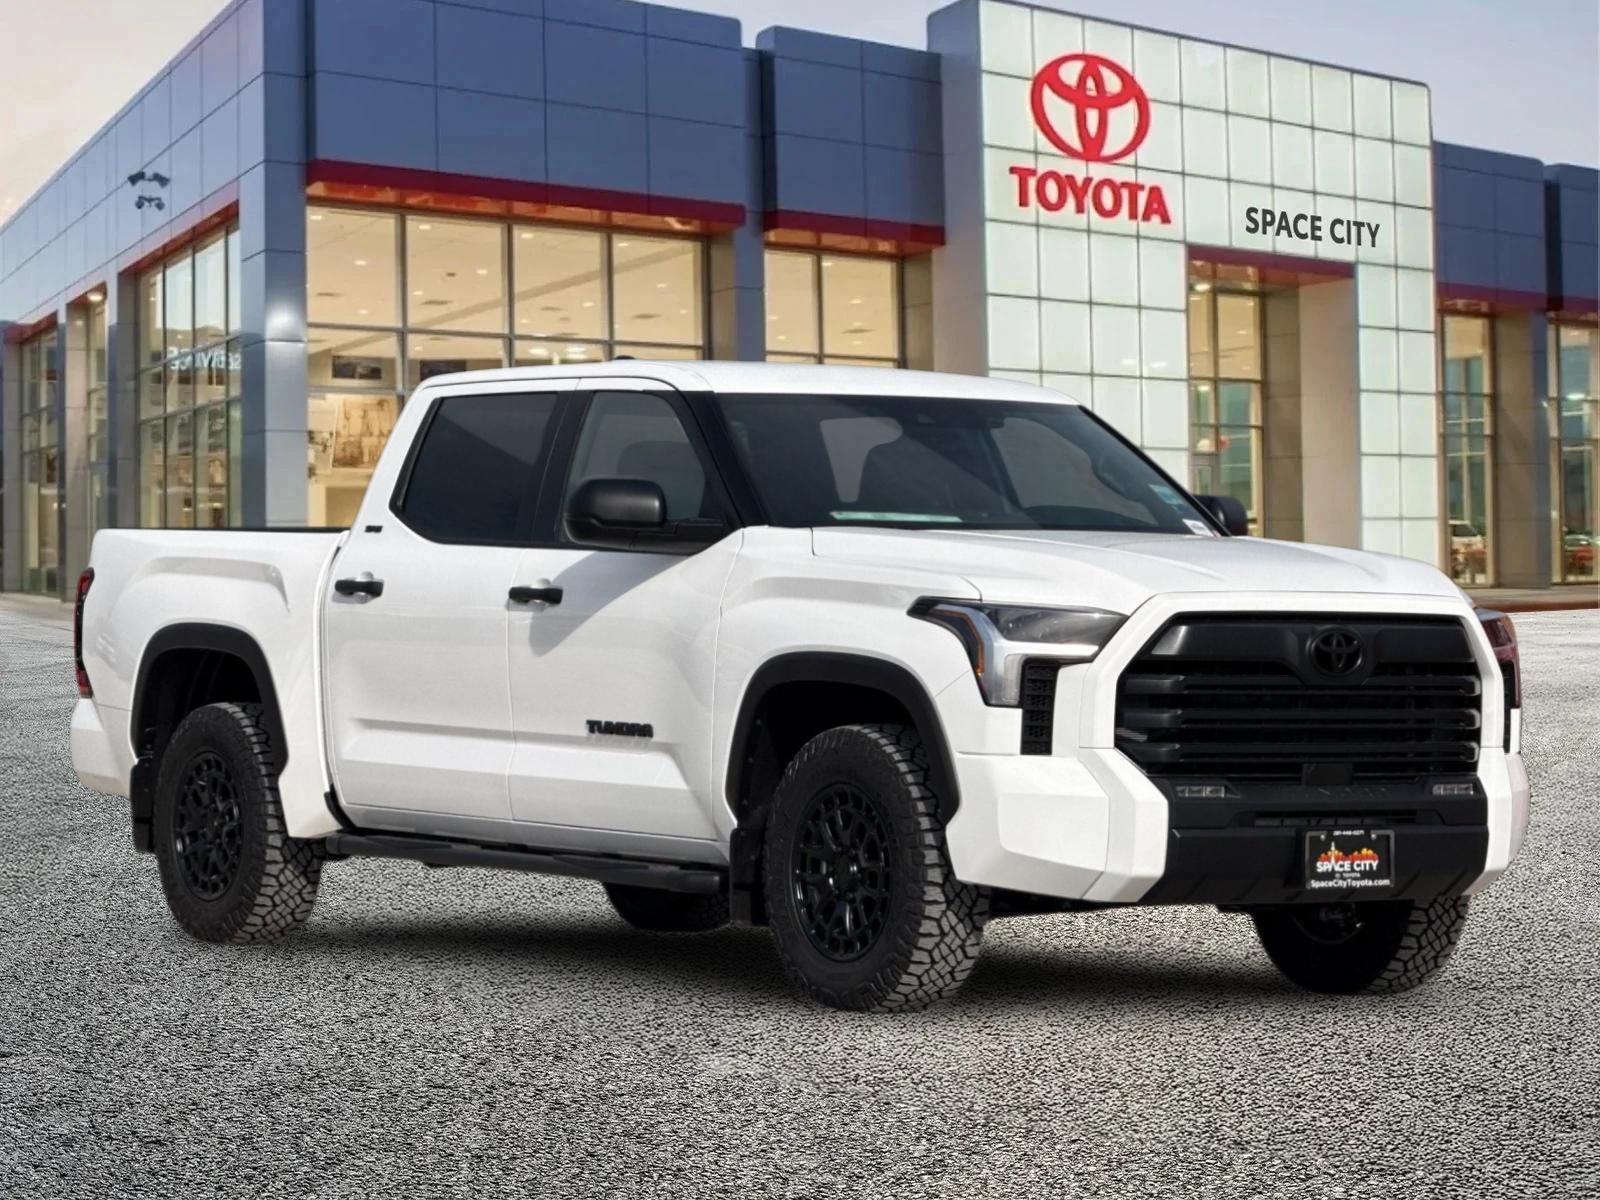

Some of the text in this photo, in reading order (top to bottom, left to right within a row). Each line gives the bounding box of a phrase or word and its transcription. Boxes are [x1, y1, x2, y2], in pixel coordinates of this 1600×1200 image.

[1009, 166, 1171, 224] TOYOTA
[1245, 206, 1381, 248] SPACE CITY
[1316, 859, 1379, 872] SPACE CITY
[1311, 879, 1391, 888] SpaceCityToyota.com
